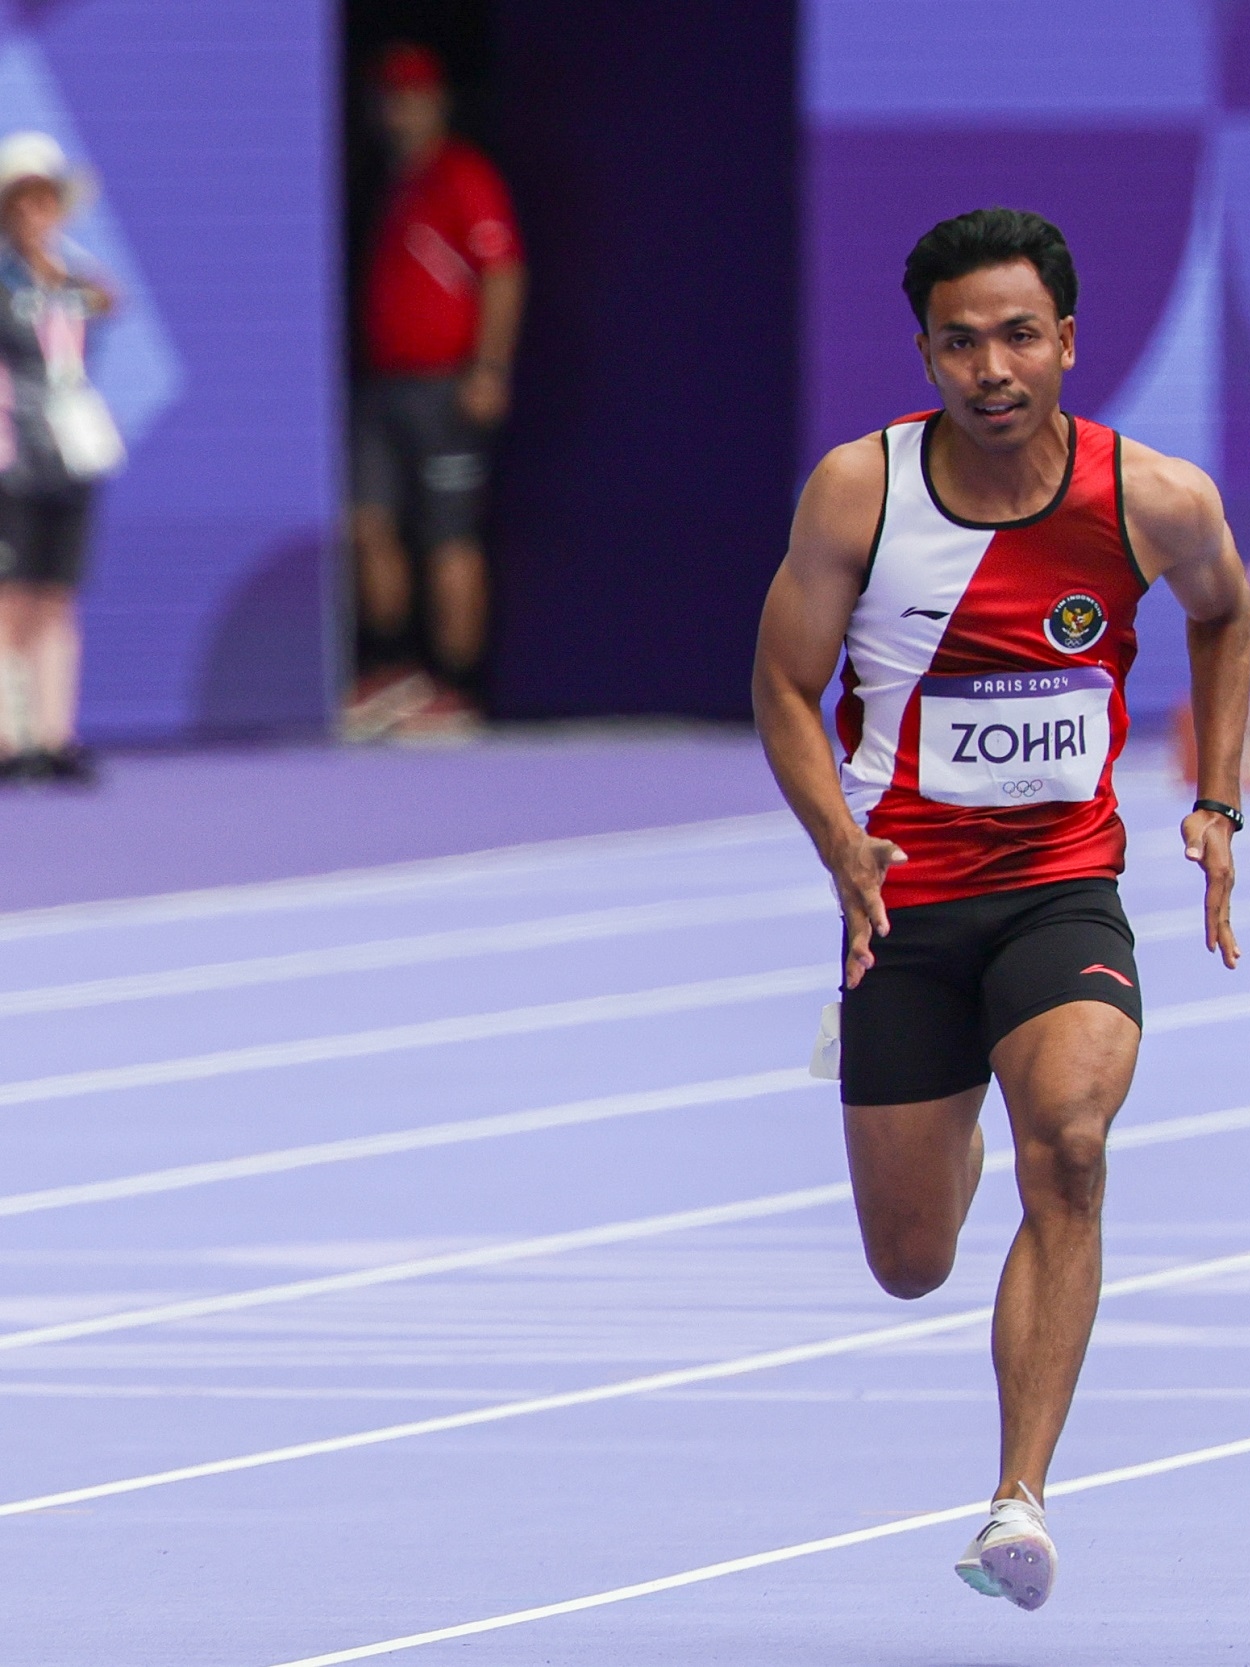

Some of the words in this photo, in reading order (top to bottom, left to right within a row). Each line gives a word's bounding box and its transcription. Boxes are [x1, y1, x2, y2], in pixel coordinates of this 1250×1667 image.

[973, 679, 1023, 693] PARIS
[1029, 676, 1069, 691] 2024
[951, 714, 1087, 764] ZOHRI
